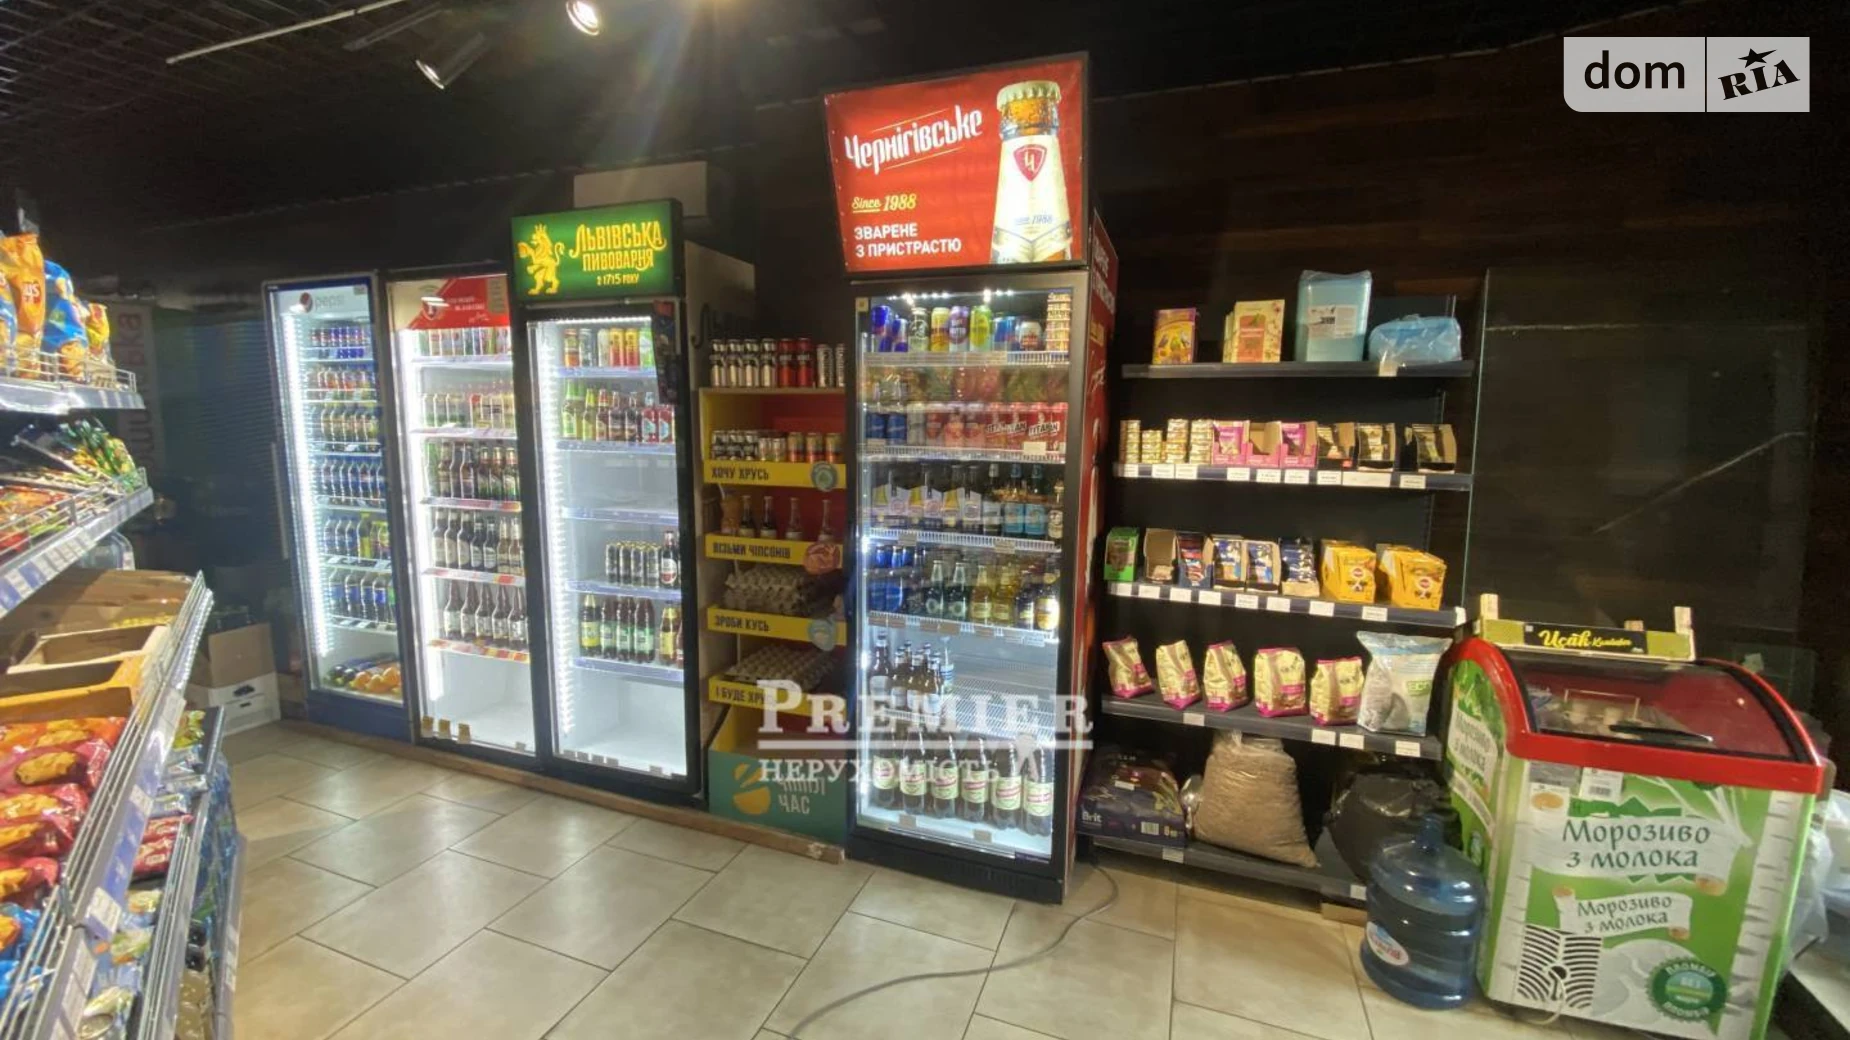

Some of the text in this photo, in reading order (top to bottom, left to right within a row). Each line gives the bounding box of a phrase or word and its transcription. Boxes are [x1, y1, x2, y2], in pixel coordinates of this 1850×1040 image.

[845, 104, 982, 175] Чернігівське
[852, 193, 917, 212] Since 1988
[569, 220, 667, 258] ЛЬВІВСЬКА
[854, 222, 918, 240] ЗВАРЕНЕ
[867, 238, 961, 256] ПРИСТРАСТЮ
[583, 249, 654, 272] ПИВОВАРНЯ
[779, 794, 810, 814] ЧАС
[1081, 811, 1103, 823] Brit
[1562, 820, 1710, 848] Морозиво
[1590, 848, 1699, 869] молока
[1577, 895, 1673, 918] Морозиво
[1601, 912, 1668, 932] молока
